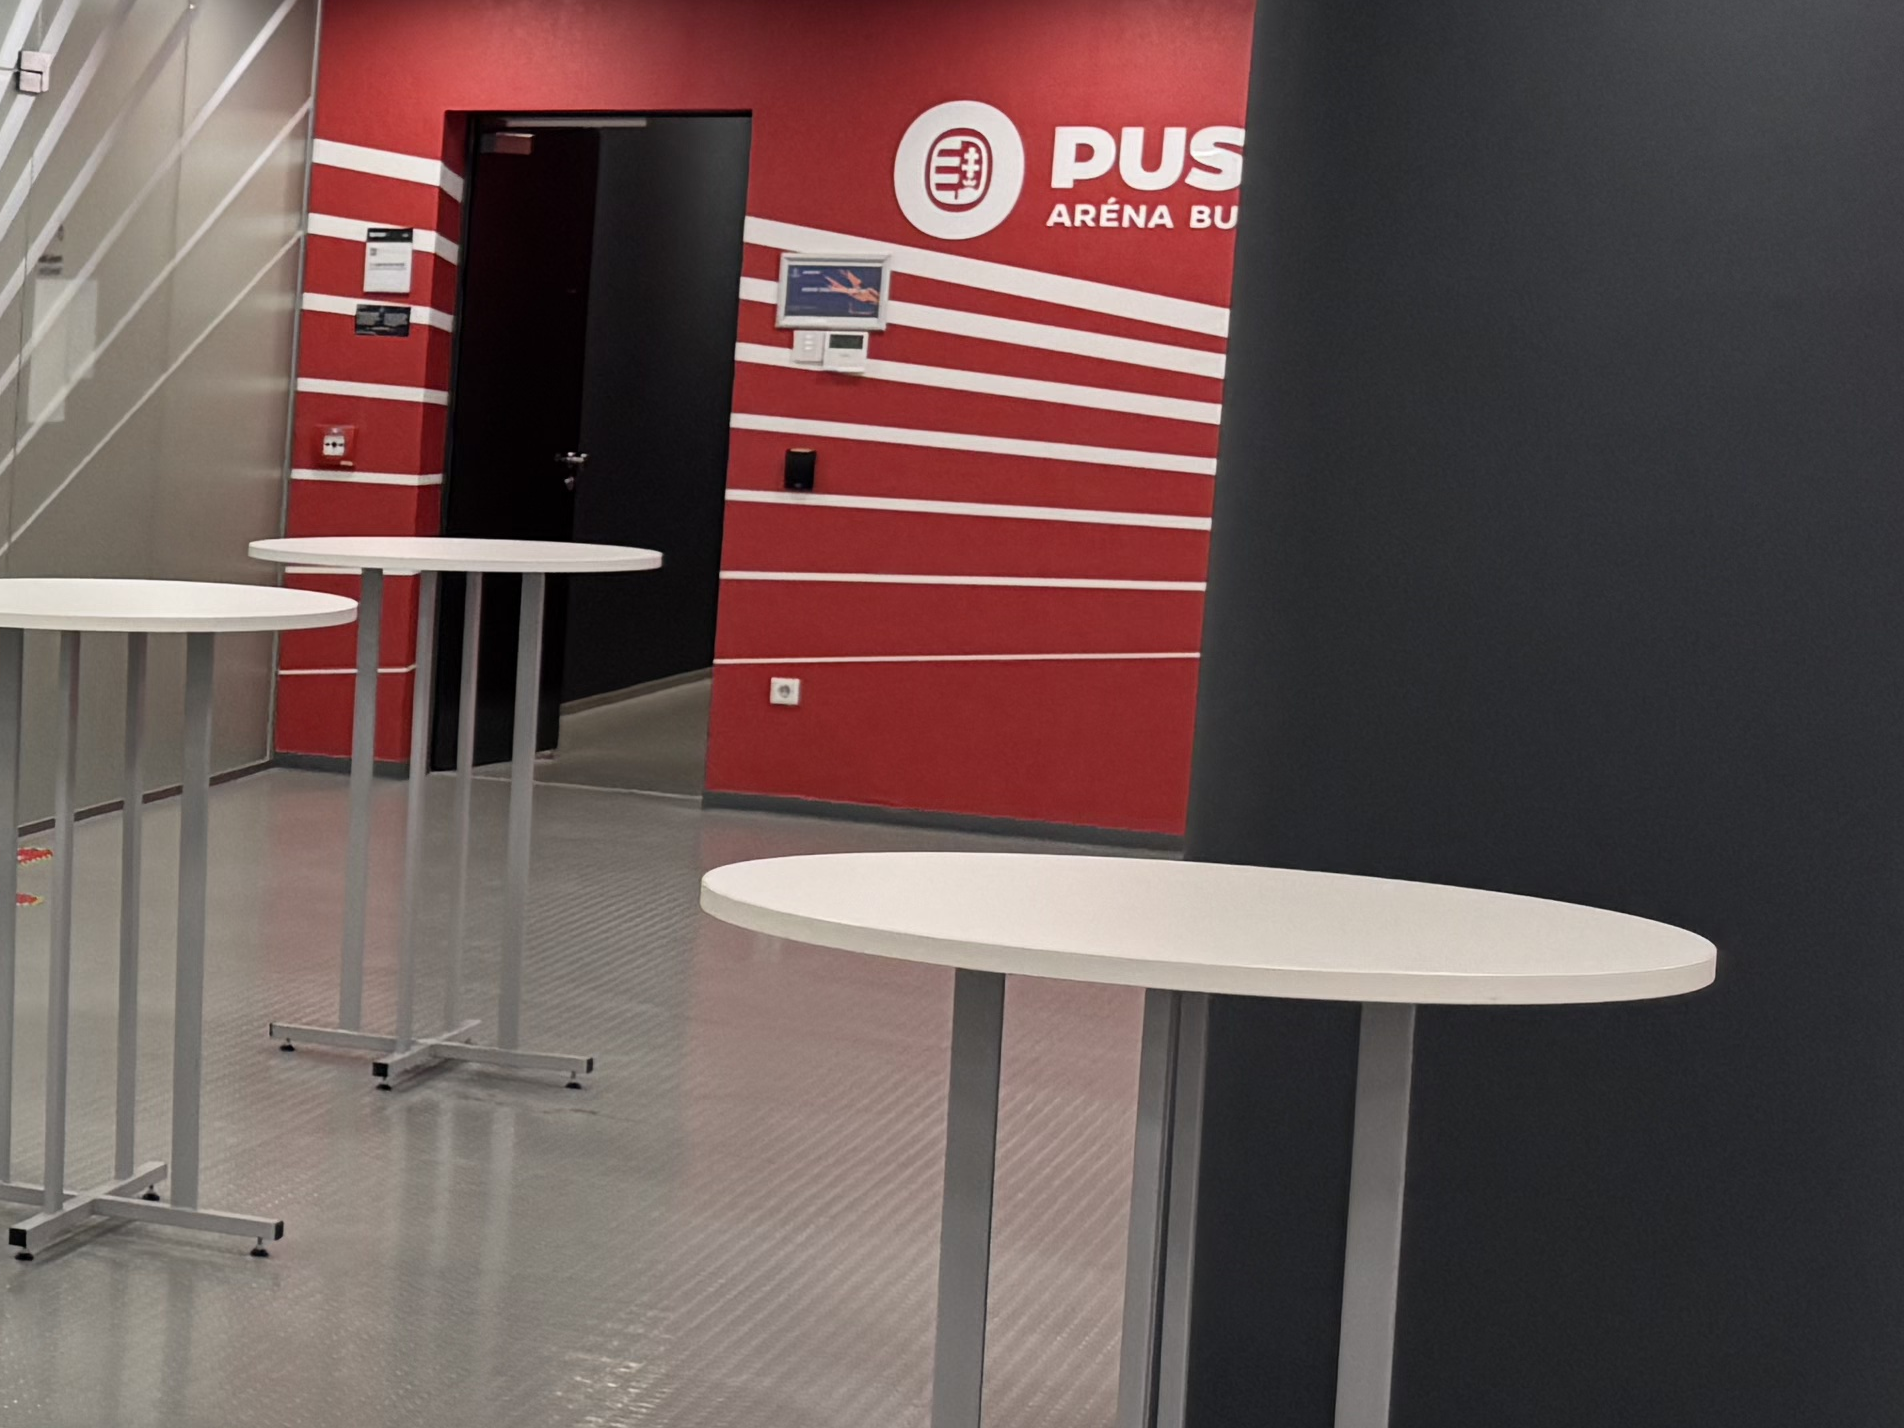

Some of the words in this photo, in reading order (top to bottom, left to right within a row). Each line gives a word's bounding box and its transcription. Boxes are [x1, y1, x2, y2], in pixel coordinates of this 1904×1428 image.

[1051, 125, 1245, 191] PUS
[1046, 197, 1174, 228] ARÉNA
[1190, 205, 1238, 230] BU
